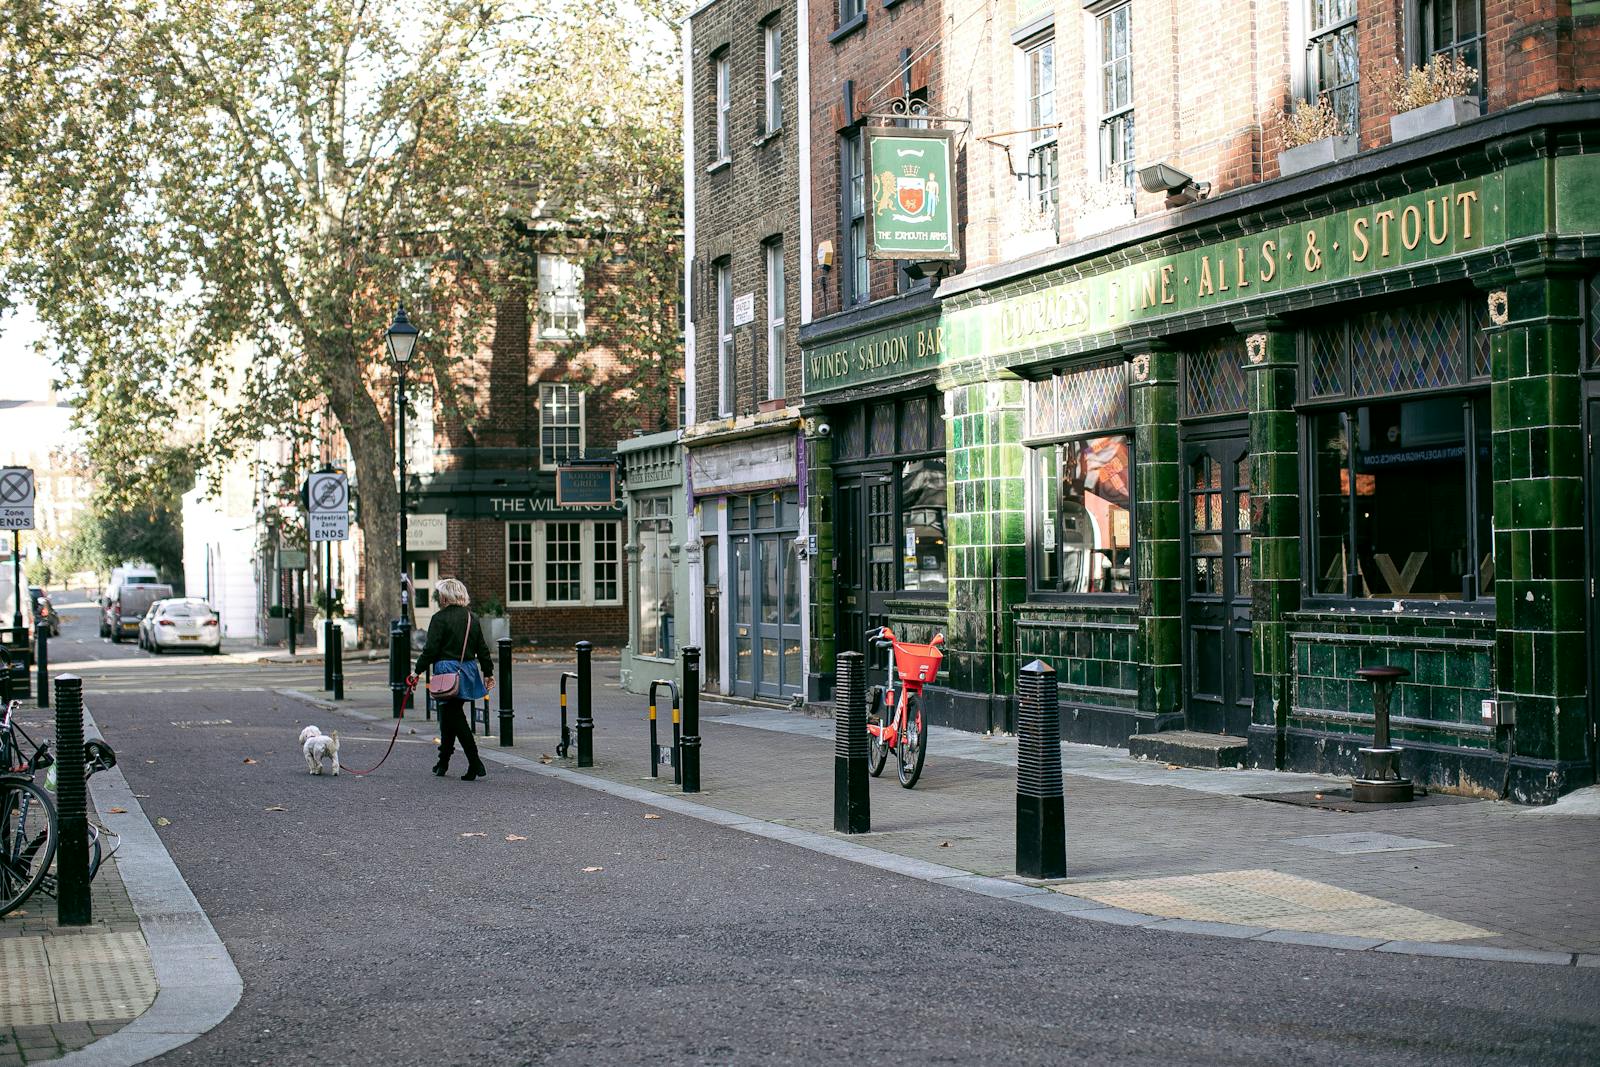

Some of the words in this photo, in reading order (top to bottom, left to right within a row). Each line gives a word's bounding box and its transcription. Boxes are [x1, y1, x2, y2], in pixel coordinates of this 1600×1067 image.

[877, 231, 892, 240] THE
[895, 231, 929, 240] EXMOUTH
[930, 232, 948, 240] ARMS
[1107, 264, 1174, 317] FINE
[1304, 230, 1322, 272] &
[1352, 190, 1478, 262] STOUT
[810, 350, 849, 380] WINES
[859, 335, 909, 371] SALOON
[917, 327, 946, 358] BAR
[573, 479, 599, 488] GRILL
[490, 498, 525, 511] THE
[0, 518, 30, 526] ENDS
[315, 529, 344, 538] ENDS
